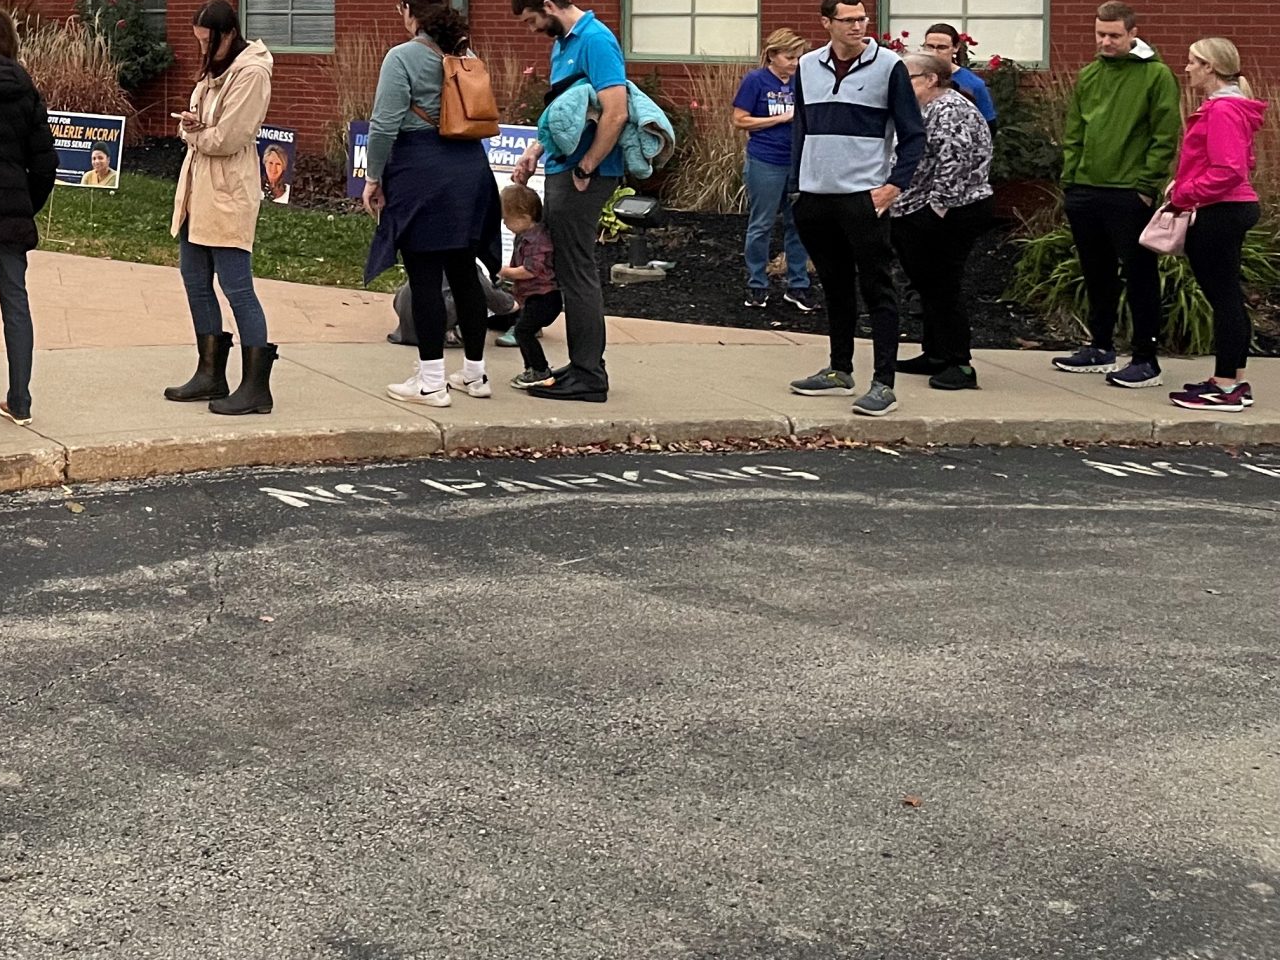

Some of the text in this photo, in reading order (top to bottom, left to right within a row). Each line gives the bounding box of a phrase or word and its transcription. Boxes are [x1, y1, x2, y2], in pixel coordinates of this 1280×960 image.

[47, 116, 59, 124] OTE
[50, 124, 119, 141] VALERIE MCCRAY
[256, 128, 294, 143] ONGRESS
[54, 139, 71, 148] TATES
[258, 465, 820, 508] NO PARKING
